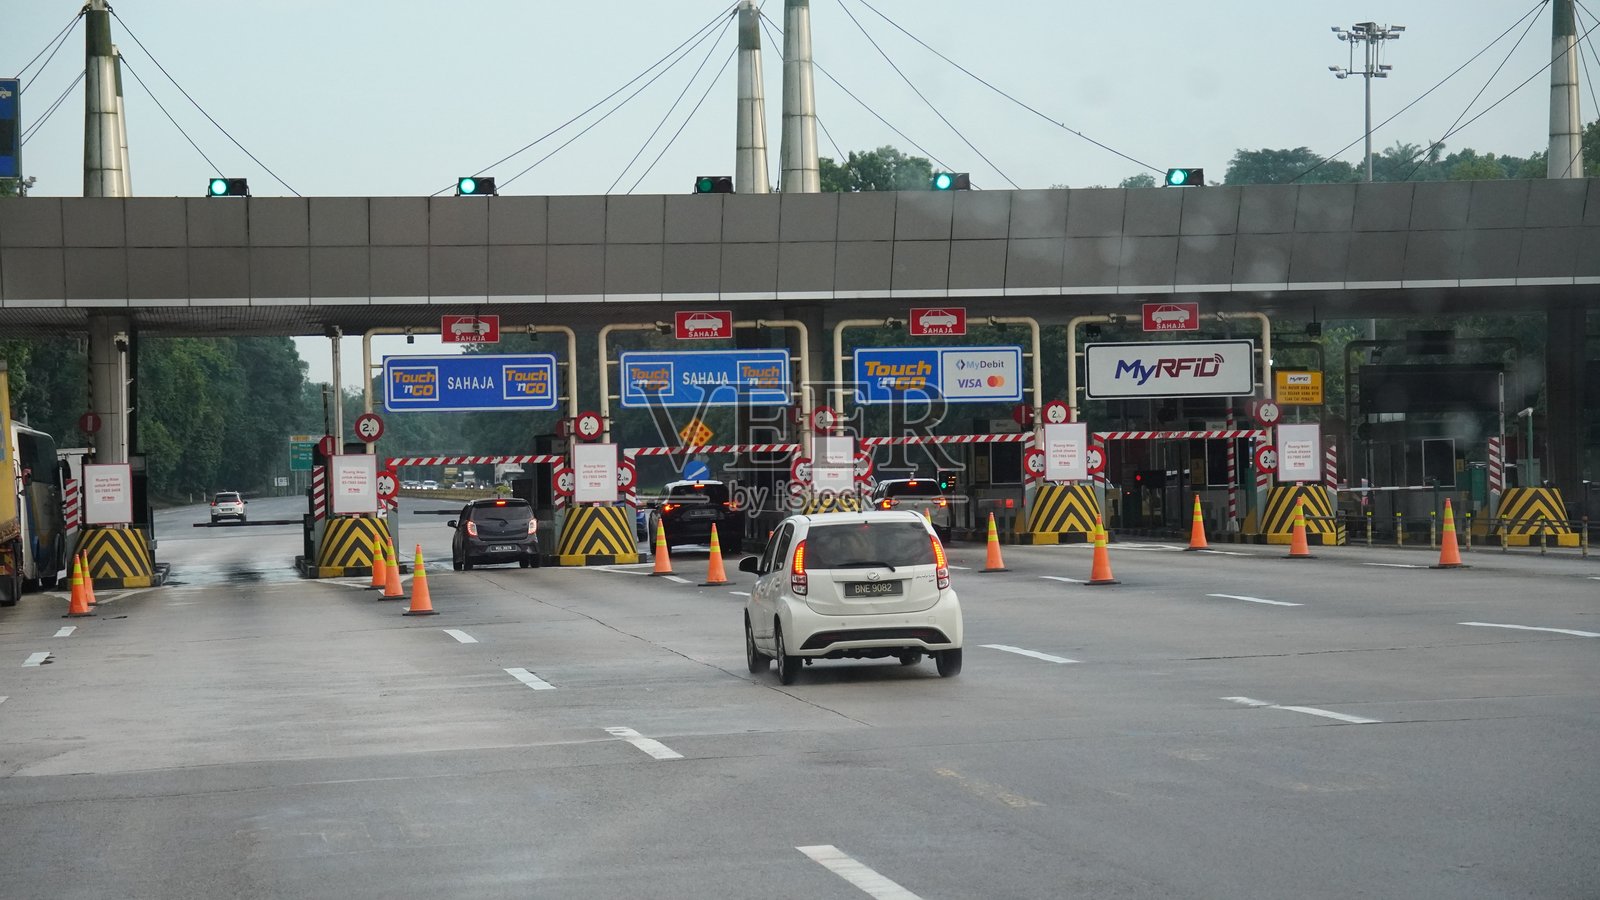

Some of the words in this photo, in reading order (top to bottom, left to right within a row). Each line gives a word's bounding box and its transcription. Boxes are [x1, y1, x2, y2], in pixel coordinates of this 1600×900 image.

[864, 360, 932, 376] Touch
[966, 359, 1004, 370] MyDebit
[506, 370, 548, 382] Touch
[630, 368, 669, 380] Touch
[741, 365, 780, 378] Touch
[393, 372, 436, 384] Touch
[447, 376, 495, 390] SAHAJA
[682, 371, 729, 386] SAHAJA
[957, 378, 983, 388] VISA
[855, 584, 871, 594] BNE
[872, 583, 892, 592] 9082
